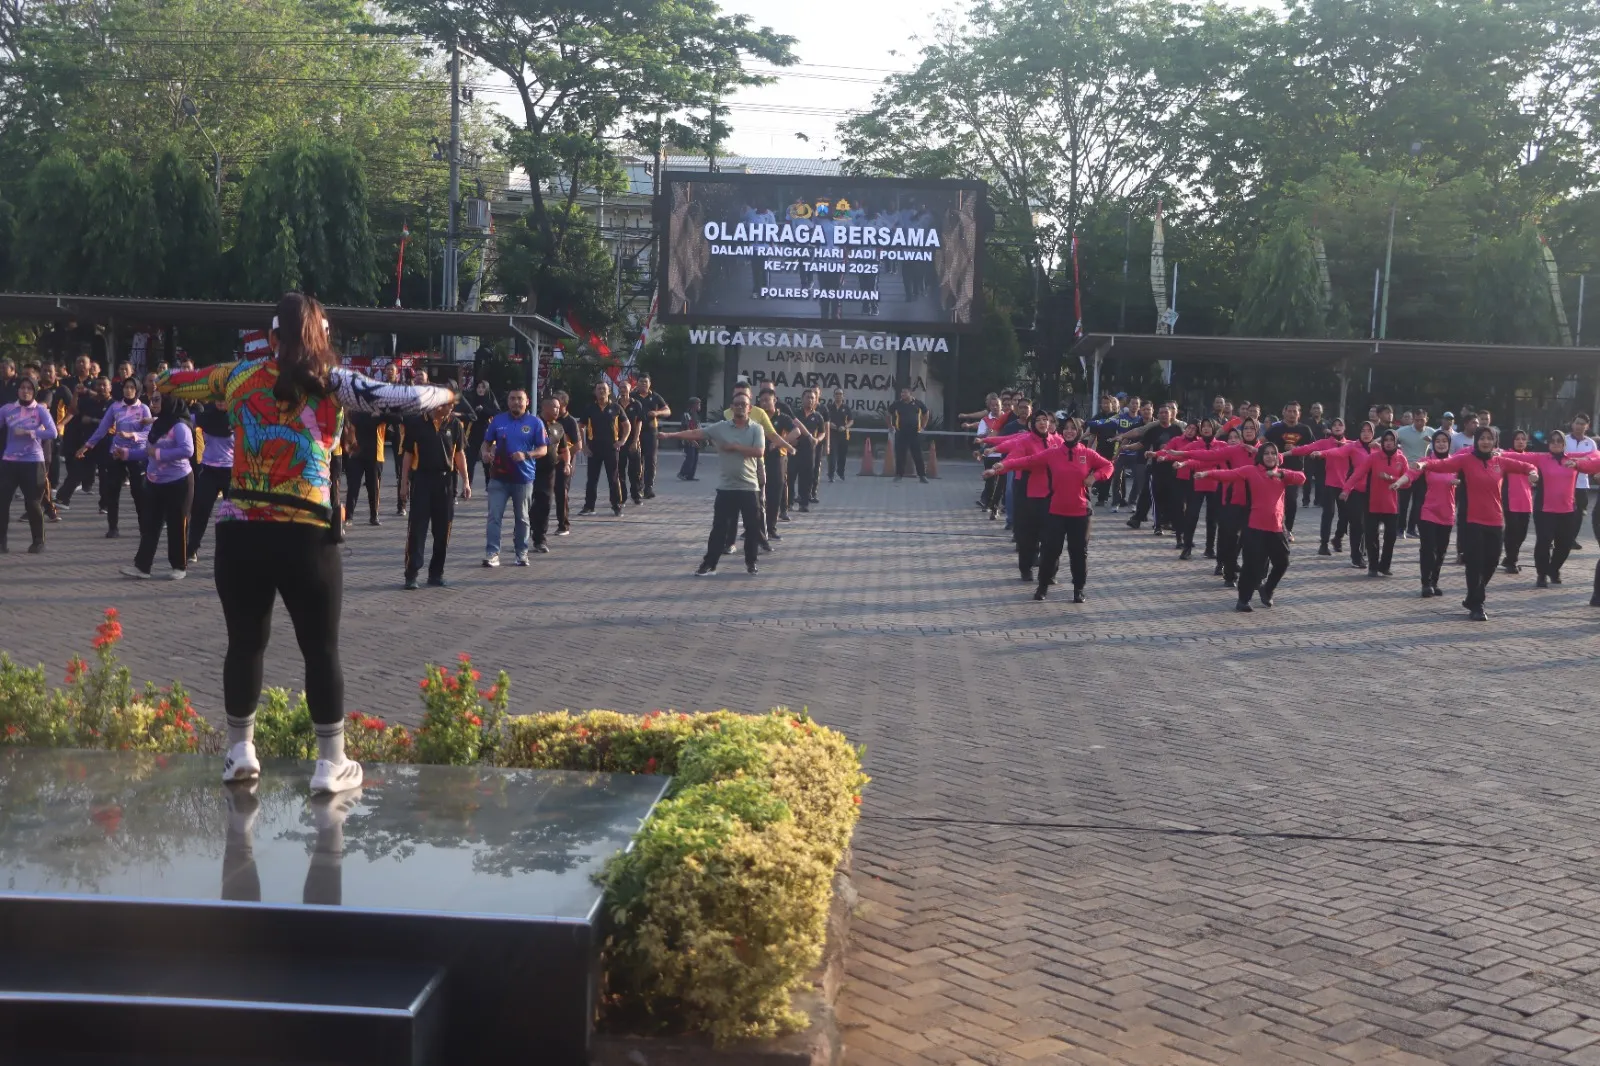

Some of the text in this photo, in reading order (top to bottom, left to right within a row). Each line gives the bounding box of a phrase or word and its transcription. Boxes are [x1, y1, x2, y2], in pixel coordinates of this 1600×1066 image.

[704, 221, 941, 247] OLAHRAGA BERSAMA
[711, 244, 933, 262] DALAM RANGKA HARI JADI POLWAN
[764, 260, 879, 274] KE-77 TAHUN 2025
[761, 287, 879, 300] POLRES PASURUAN
[689, 329, 949, 353] WICAKSANA LAGHAWA
[767, 350, 888, 365] LAPANGAN APEL
[791, 371, 842, 389] ARYA
